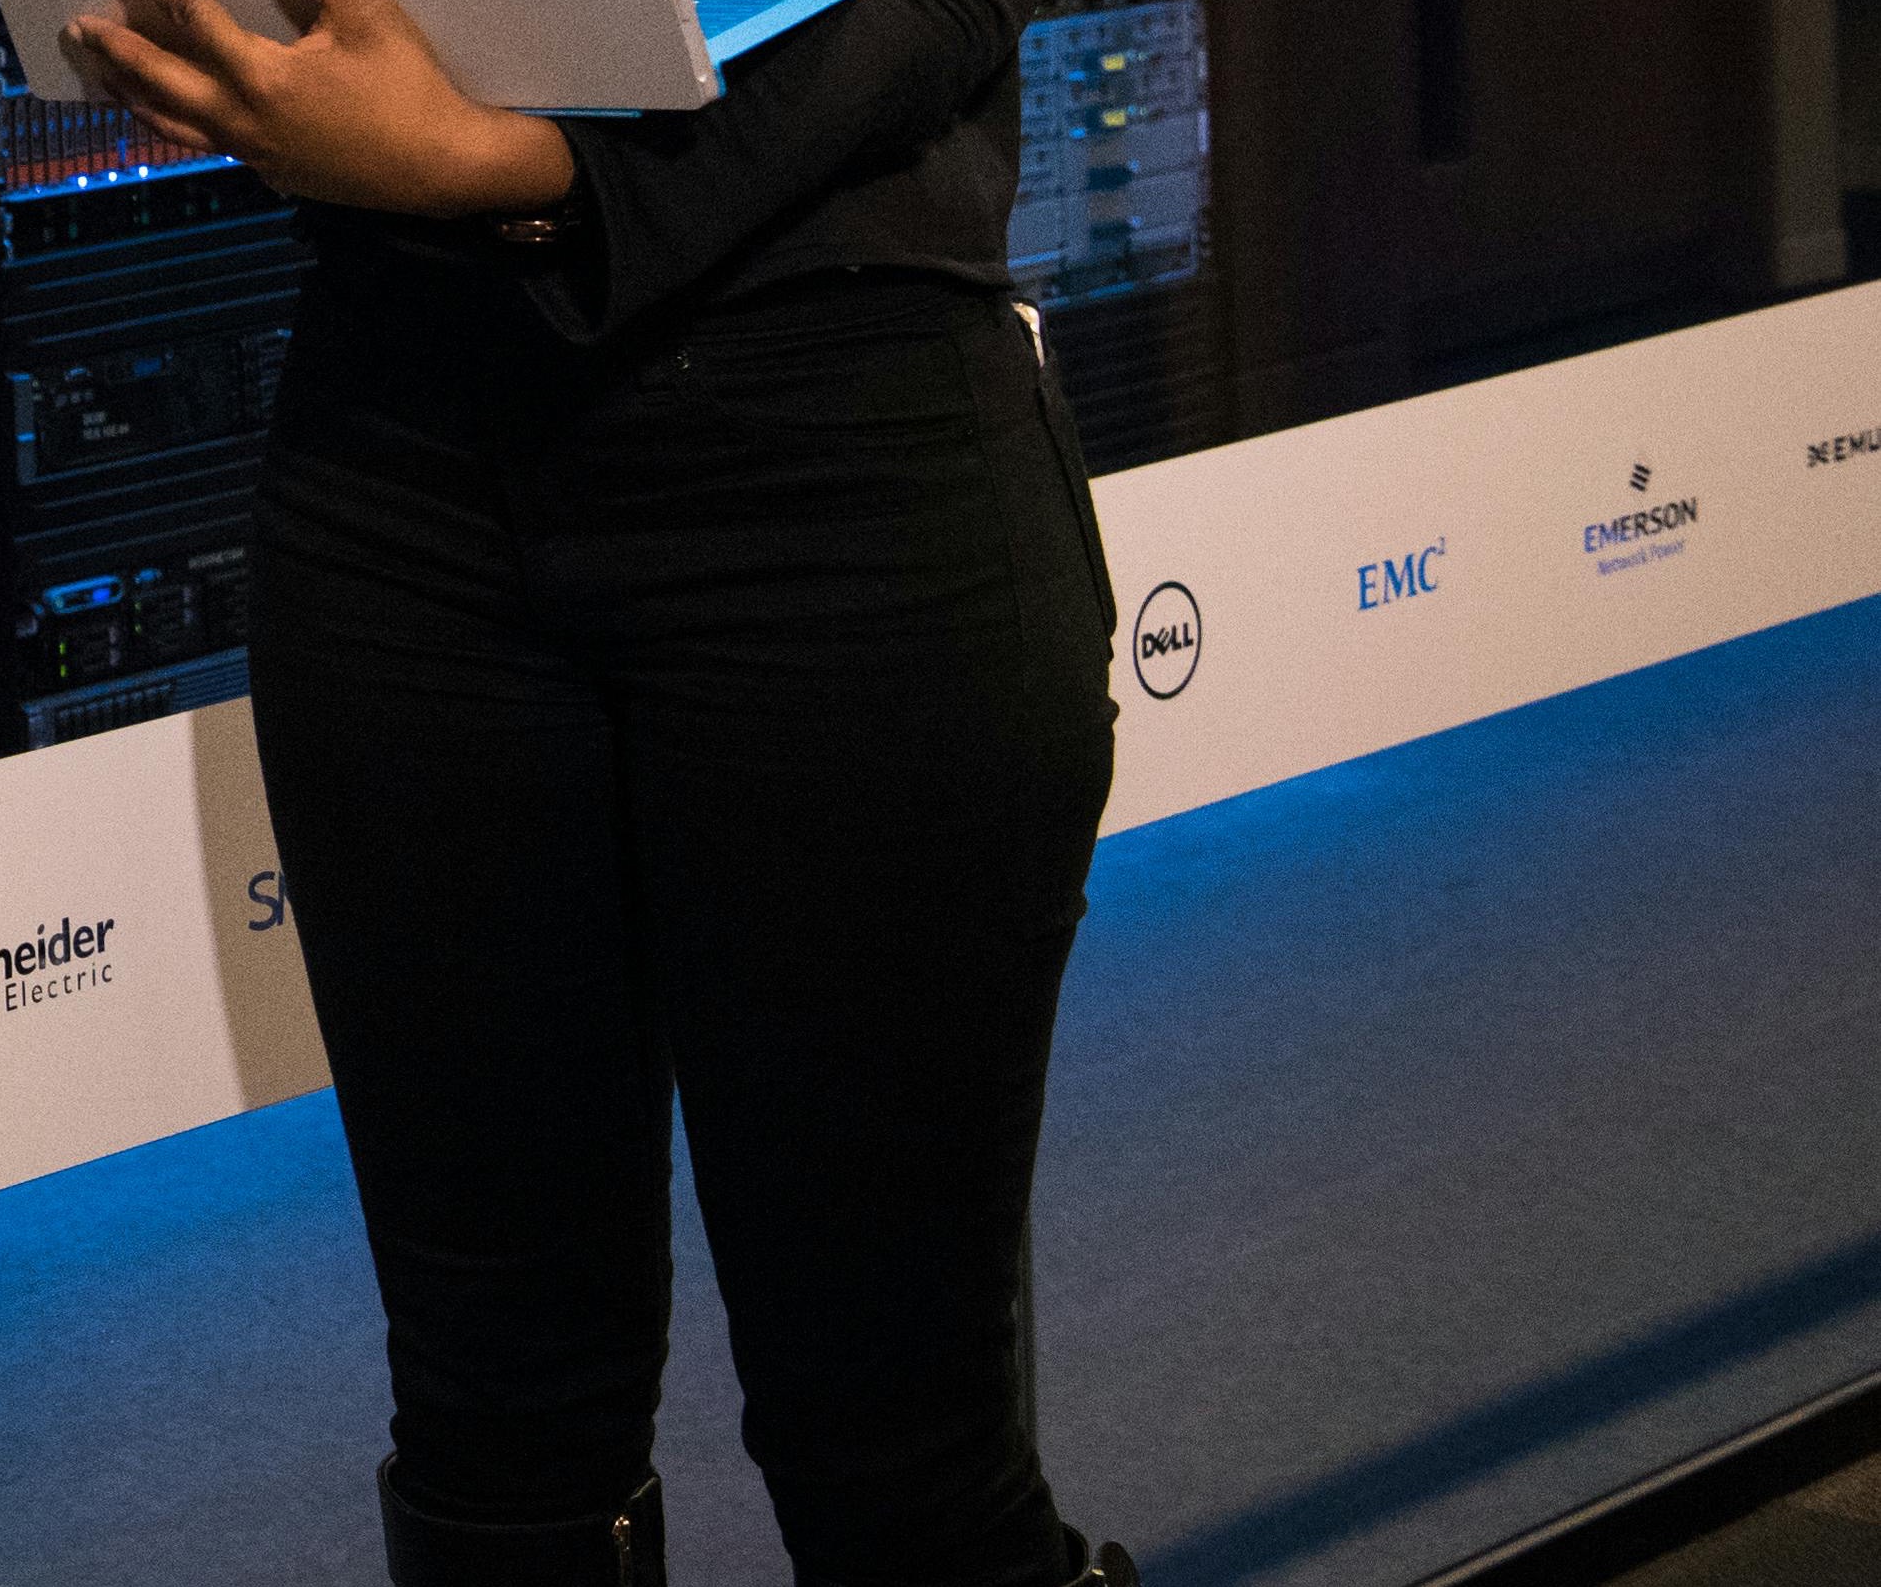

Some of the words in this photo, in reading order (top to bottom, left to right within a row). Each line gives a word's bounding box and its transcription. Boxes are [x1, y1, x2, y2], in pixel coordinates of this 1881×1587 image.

[1583, 497, 1697, 554] EMERSON
[1141, 622, 1194, 660] DELL
[4, 962, 113, 1014] Electric
